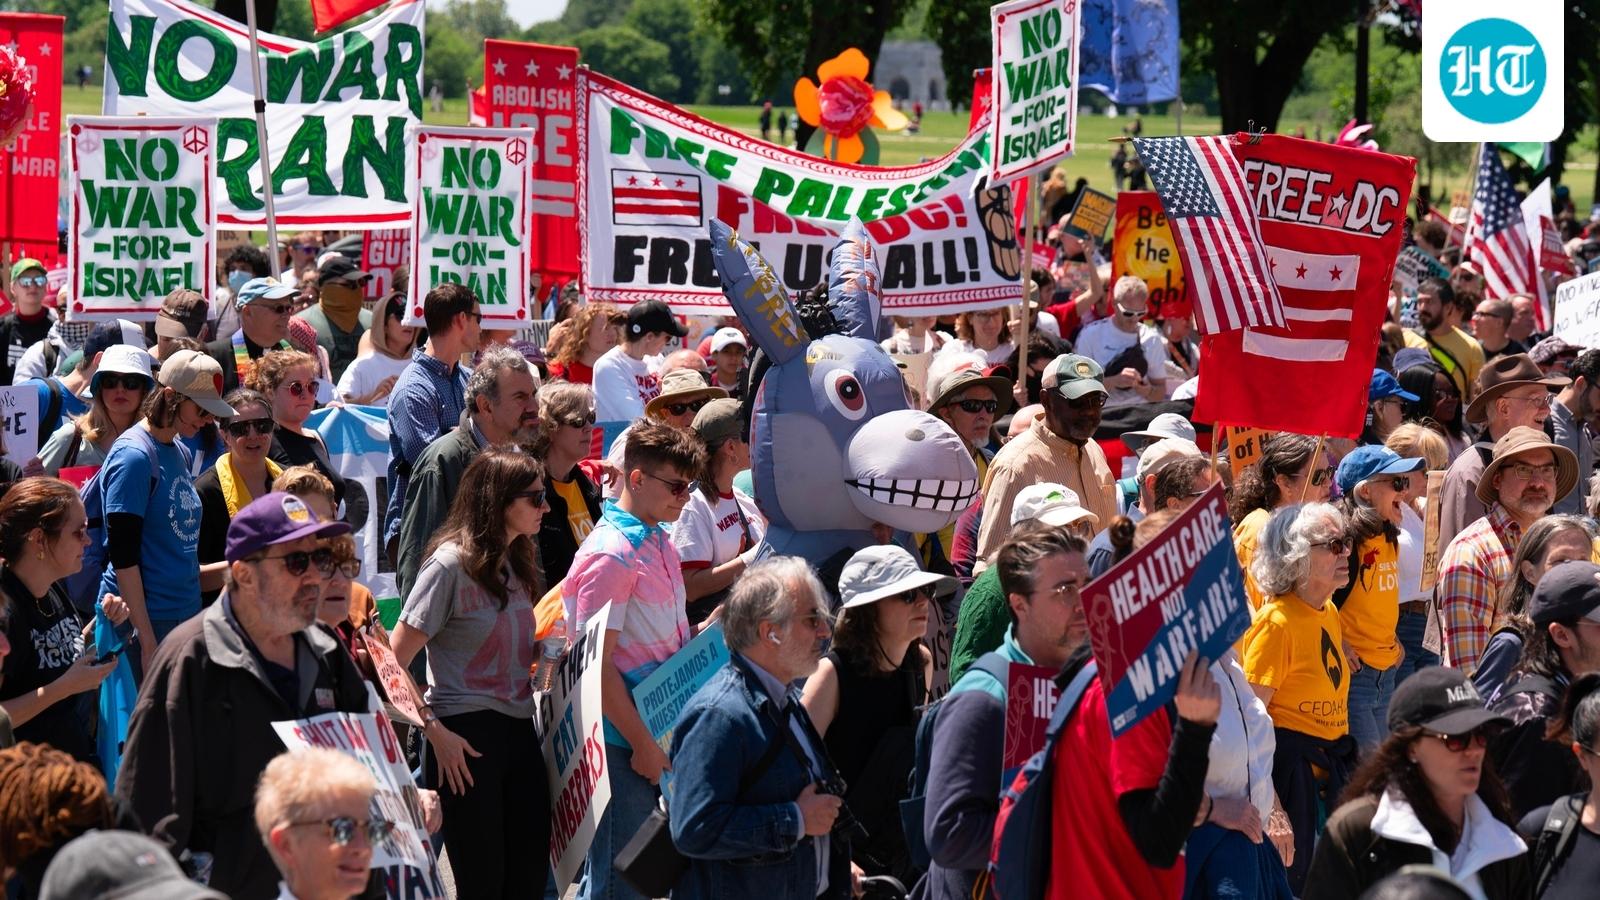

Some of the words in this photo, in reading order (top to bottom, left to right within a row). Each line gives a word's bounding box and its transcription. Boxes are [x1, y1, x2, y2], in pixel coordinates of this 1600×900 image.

[1020, 7, 1062, 59] NO
[106, 12, 237, 102] NO
[262, 23, 423, 120] WAR
[1003, 47, 1071, 104] WAR
[493, 85, 571, 110] ABOLISH
[12, 155, 57, 177] WAR
[103, 138, 179, 181] NO
[217, 115, 408, 210] RAN
[610, 106, 738, 181] FREE
[1002, 111, 1068, 166] ISRAEL
[441, 147, 502, 190] NO
[81, 179, 204, 237] WAR
[423, 187, 521, 247] WAR
[1137, 206, 1166, 230] Be
[1243, 158, 1333, 225] FREE
[1344, 181, 1399, 236] DC
[613, 235, 760, 288] FRE
[783, 243, 834, 290] U
[882, 236, 981, 289] ALL!
[1134, 238, 1170, 264] the
[83, 261, 202, 302] ISRAEL
[1235, 438, 1253, 460] of
[1160, 585, 1187, 626] NOT
[558, 620, 600, 698] THEM
[1127, 566, 1238, 702] WARFARE
[643, 647, 708, 715] PROTEJAMOS
[711, 641, 718, 660] A
[553, 701, 578, 776] EAT
